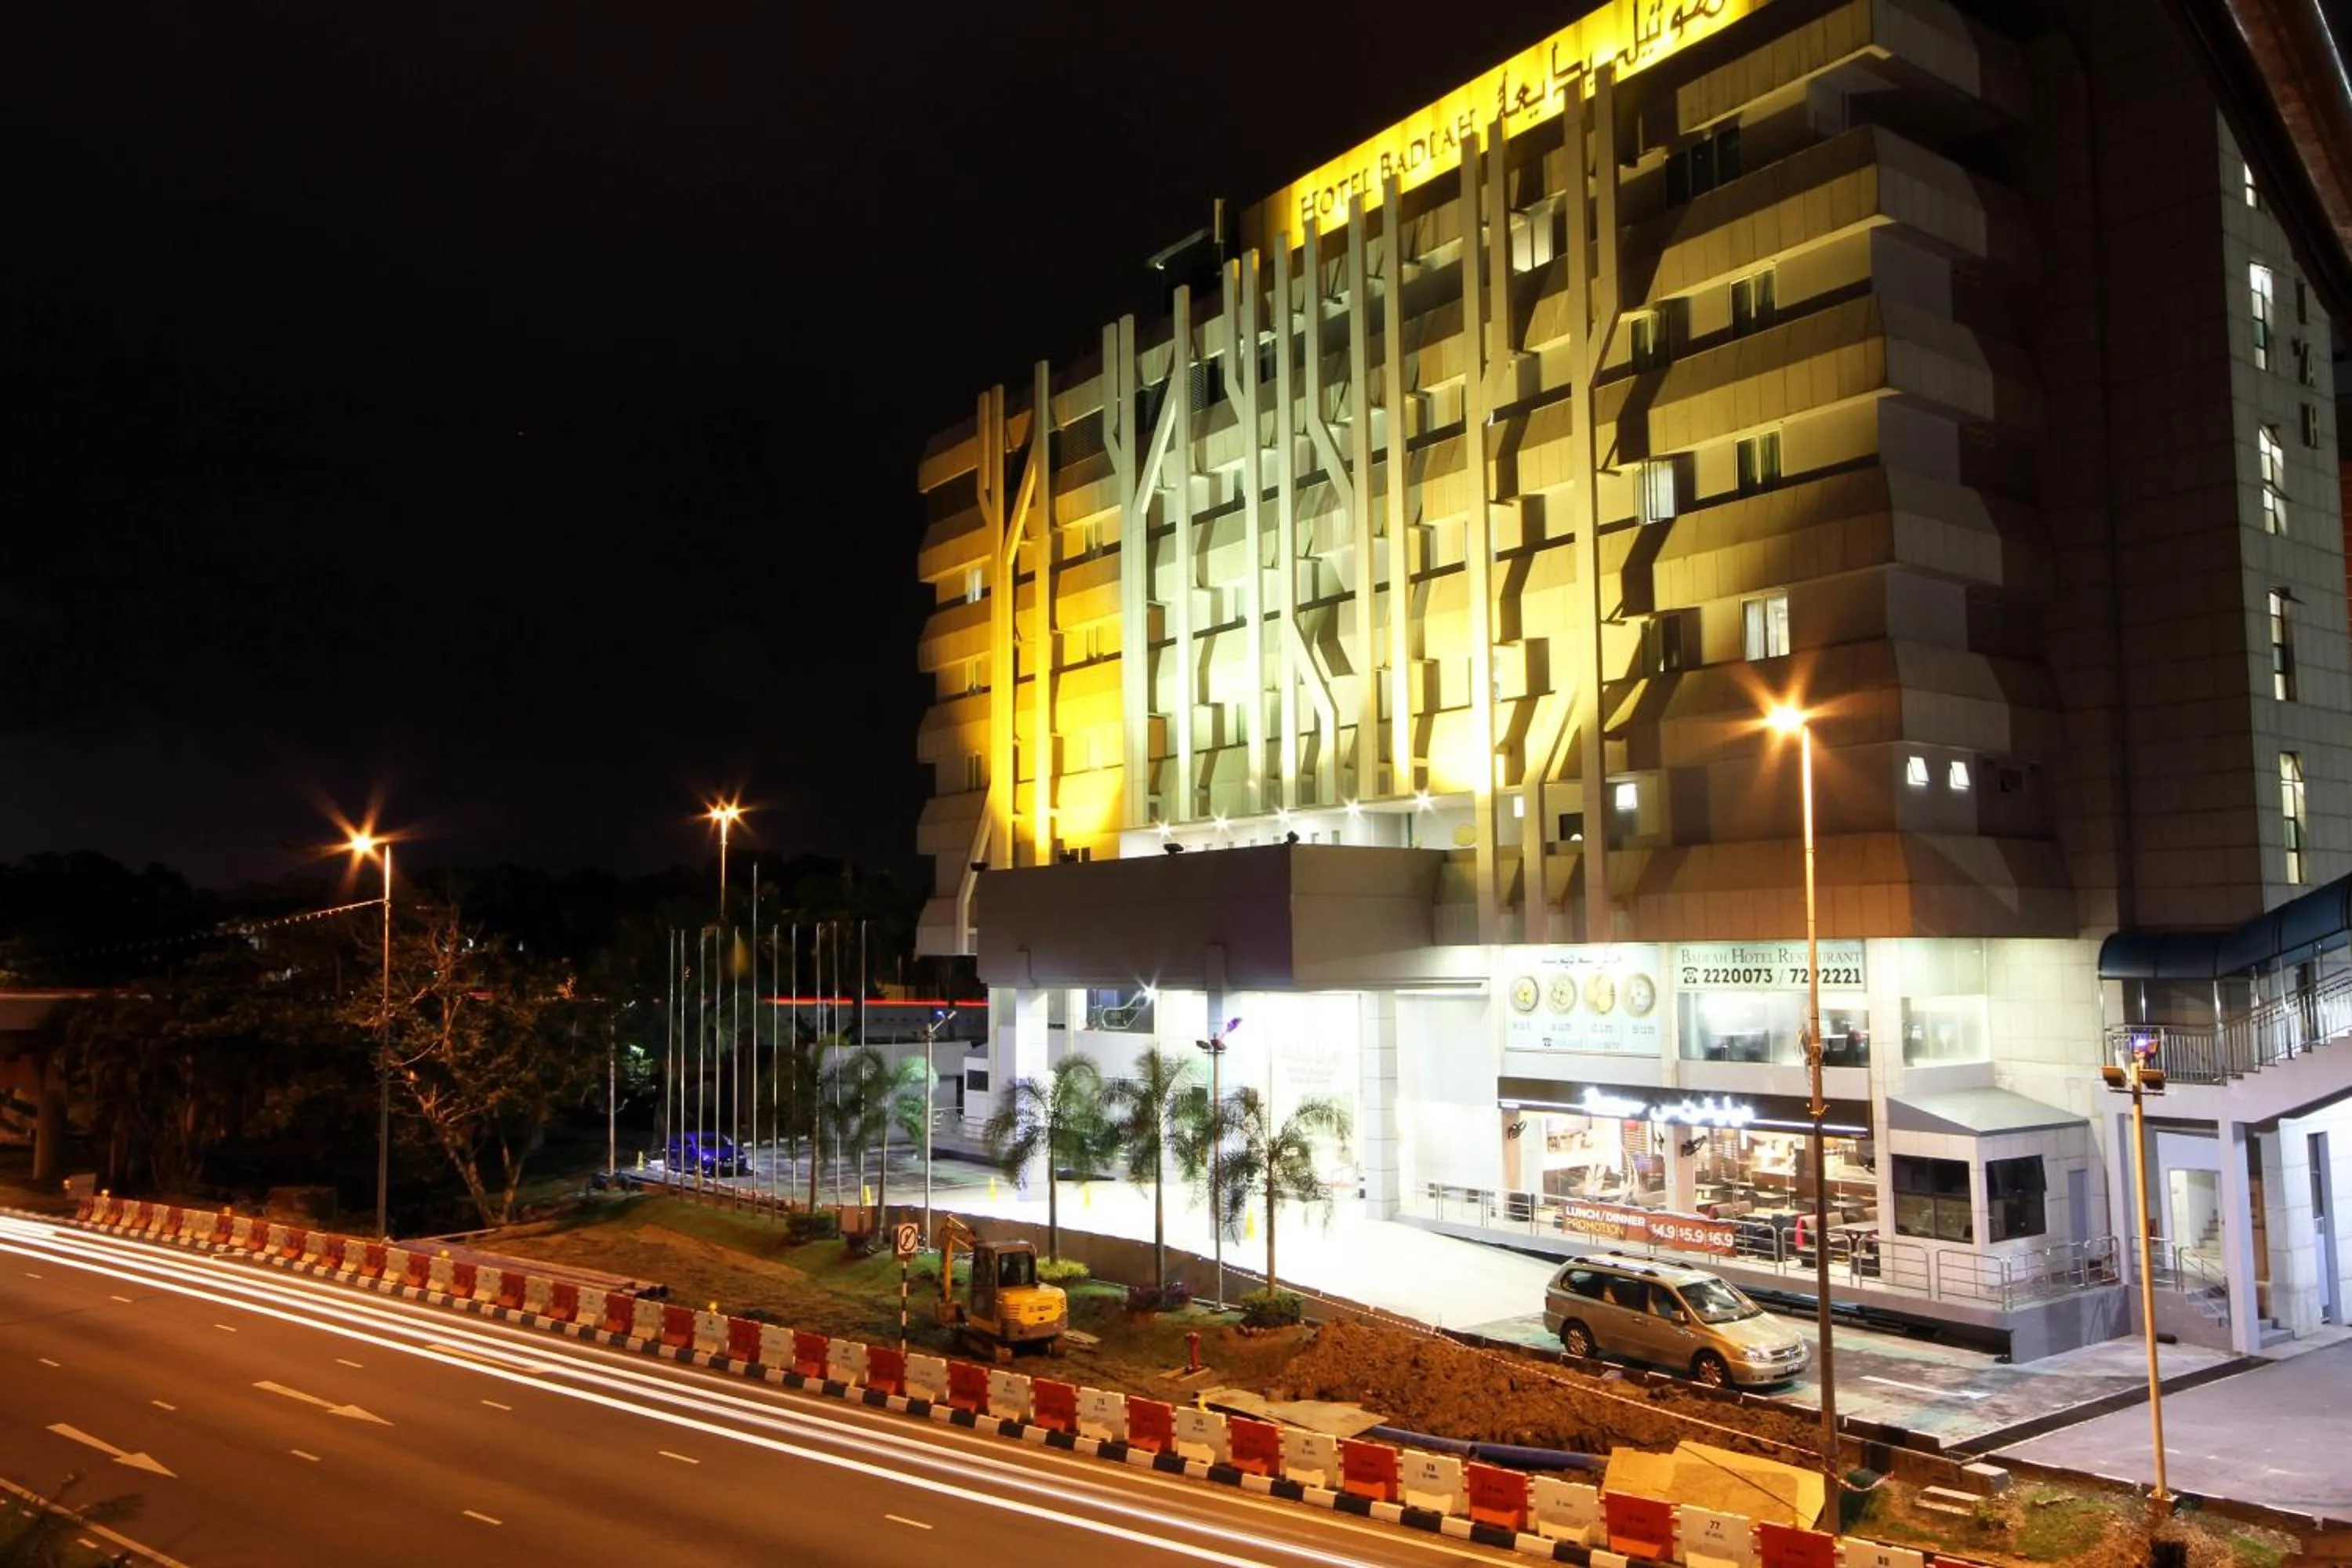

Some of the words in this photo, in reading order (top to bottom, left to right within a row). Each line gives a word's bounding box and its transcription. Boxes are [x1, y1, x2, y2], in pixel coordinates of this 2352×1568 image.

[1301, 168, 1372, 224] HOTEL
[1732, 947, 1773, 964] HOTEL
[1778, 947, 1860, 964] RESTURANT
[1703, 967, 1773, 984] 2220073
[1566, 1217, 1624, 1237] PROMOTION
